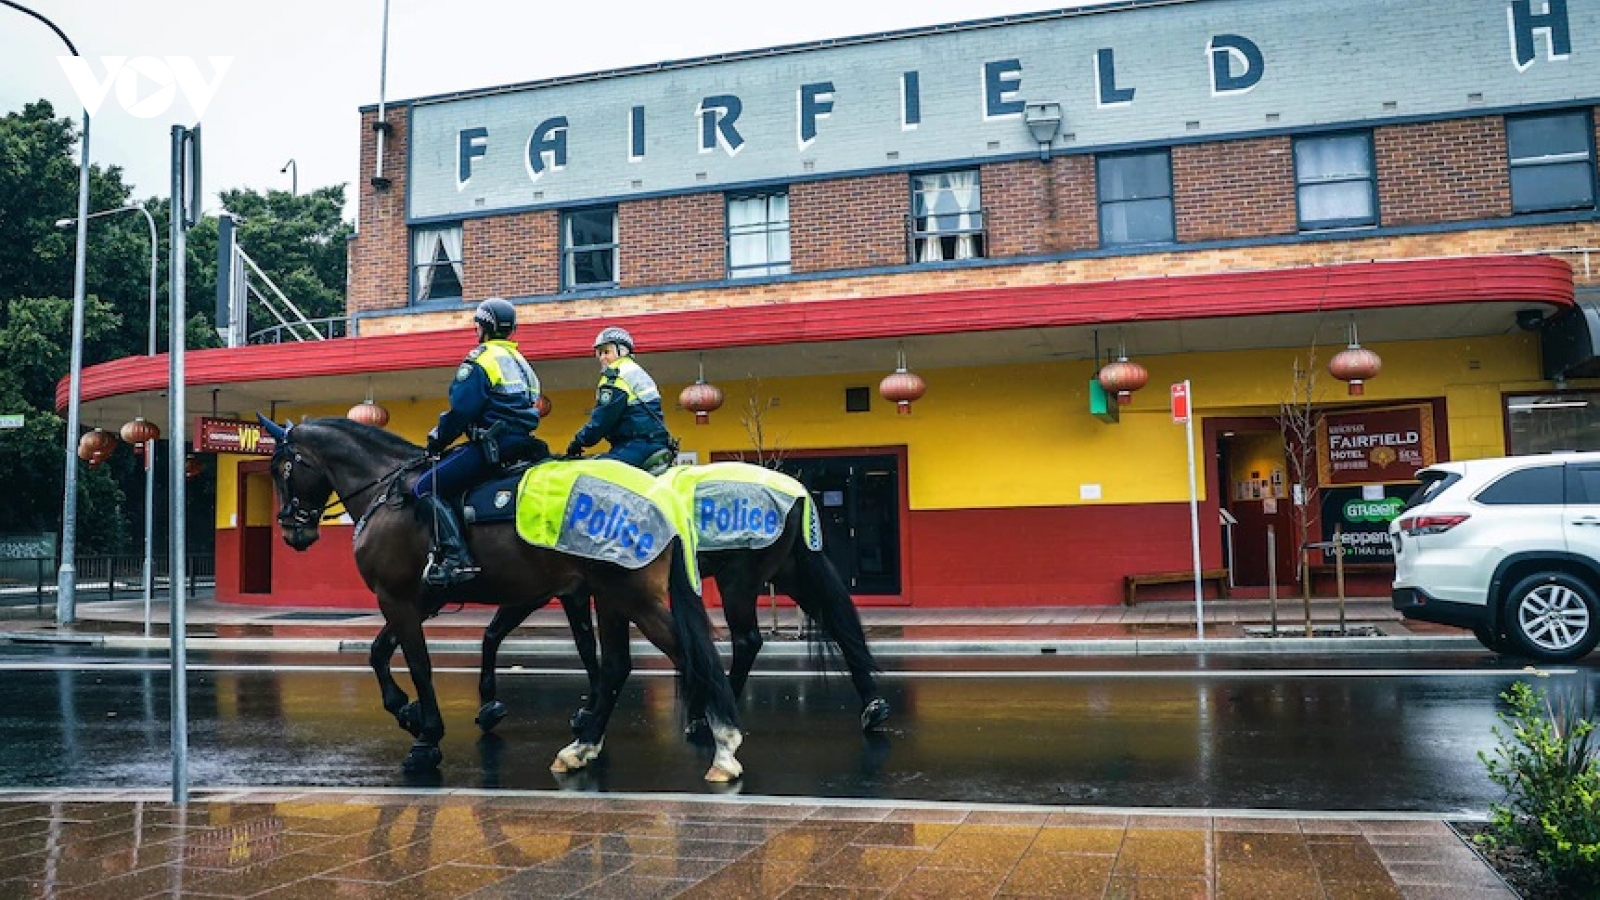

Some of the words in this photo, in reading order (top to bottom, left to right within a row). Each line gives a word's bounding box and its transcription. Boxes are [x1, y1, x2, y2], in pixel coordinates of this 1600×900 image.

[457, 33, 1265, 191] FAIRFIELD
[238, 428, 260, 450] VIP
[1330, 431, 1419, 449] FAIRFIELD
[1330, 449, 1365, 460] HOTEL
[569, 493, 655, 557] Police
[700, 497, 777, 534] Police
